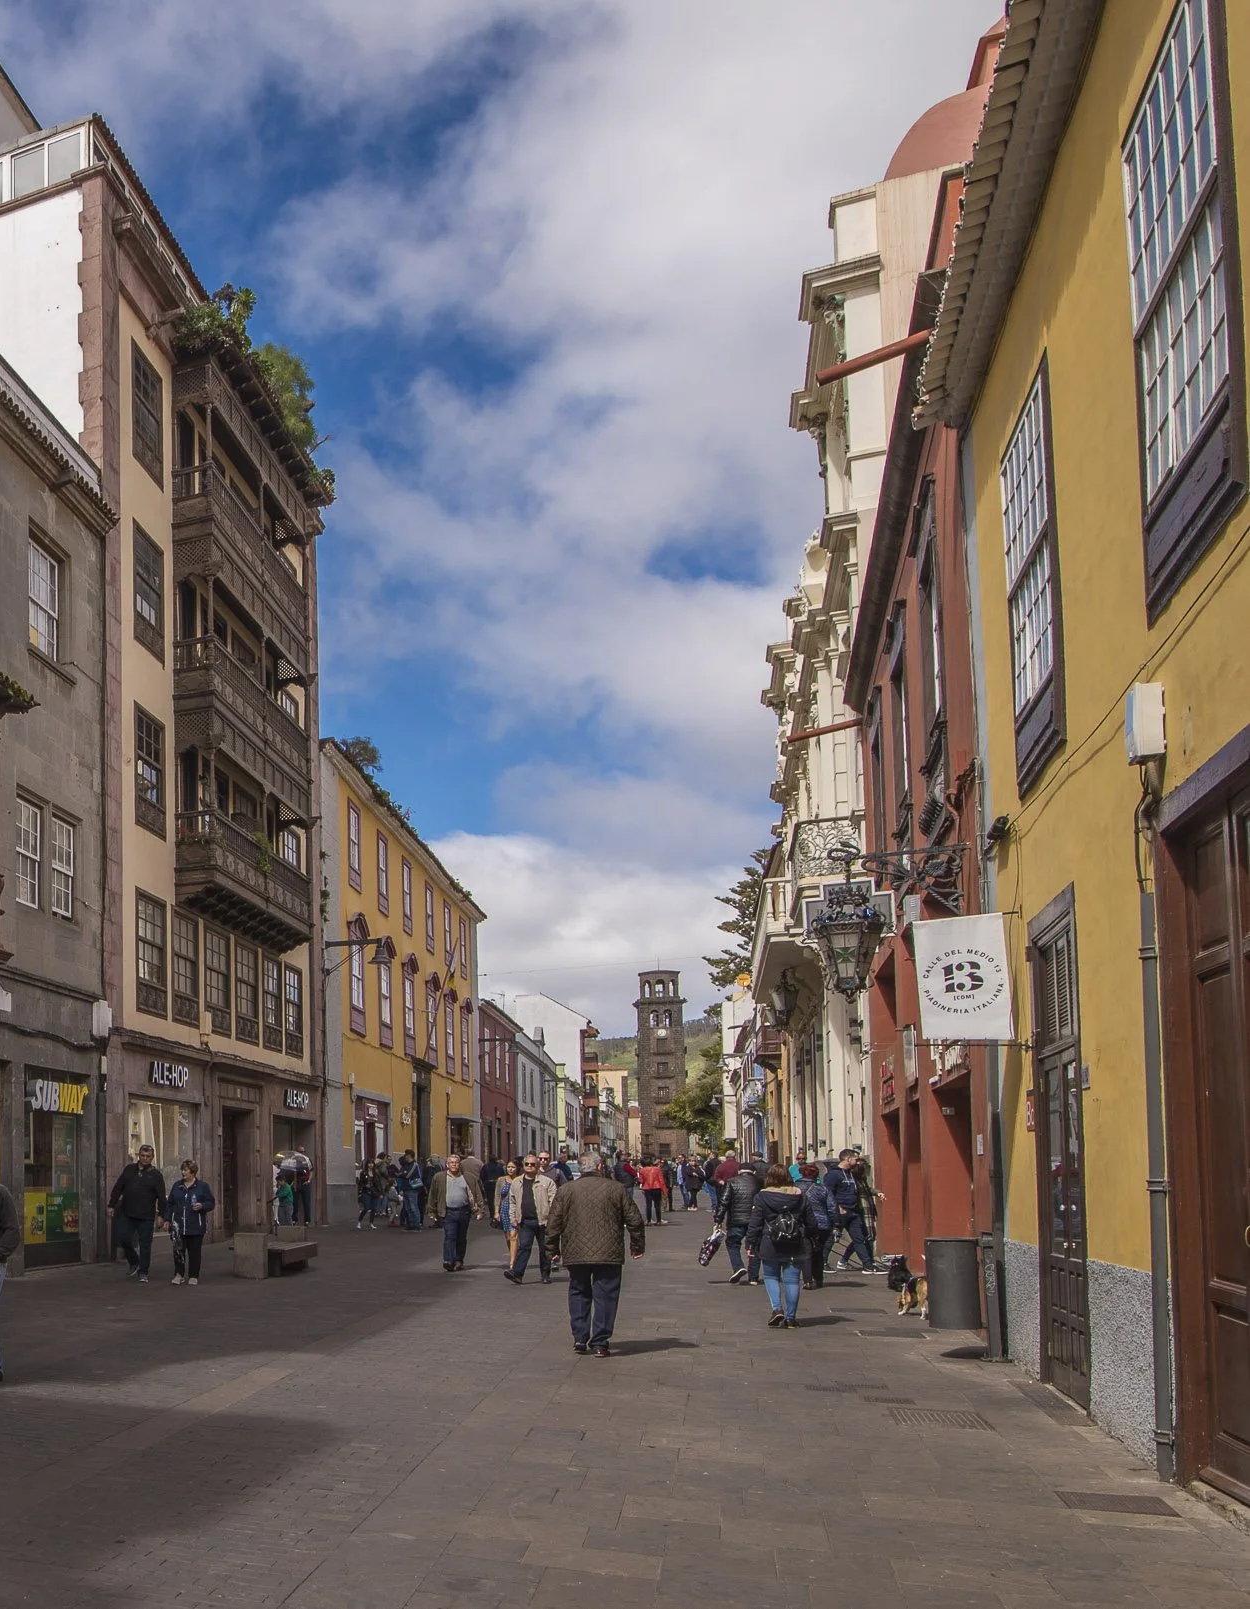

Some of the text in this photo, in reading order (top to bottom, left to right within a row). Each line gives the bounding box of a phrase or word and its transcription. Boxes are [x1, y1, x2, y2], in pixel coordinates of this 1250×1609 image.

[922, 948, 1002, 979] CALLE DEL MEDIO 13
[942, 961, 984, 993] 13
[924, 983, 1004, 1014] PIADINERIA ITALIANA
[31, 1079, 88, 1114] SUBWAY
